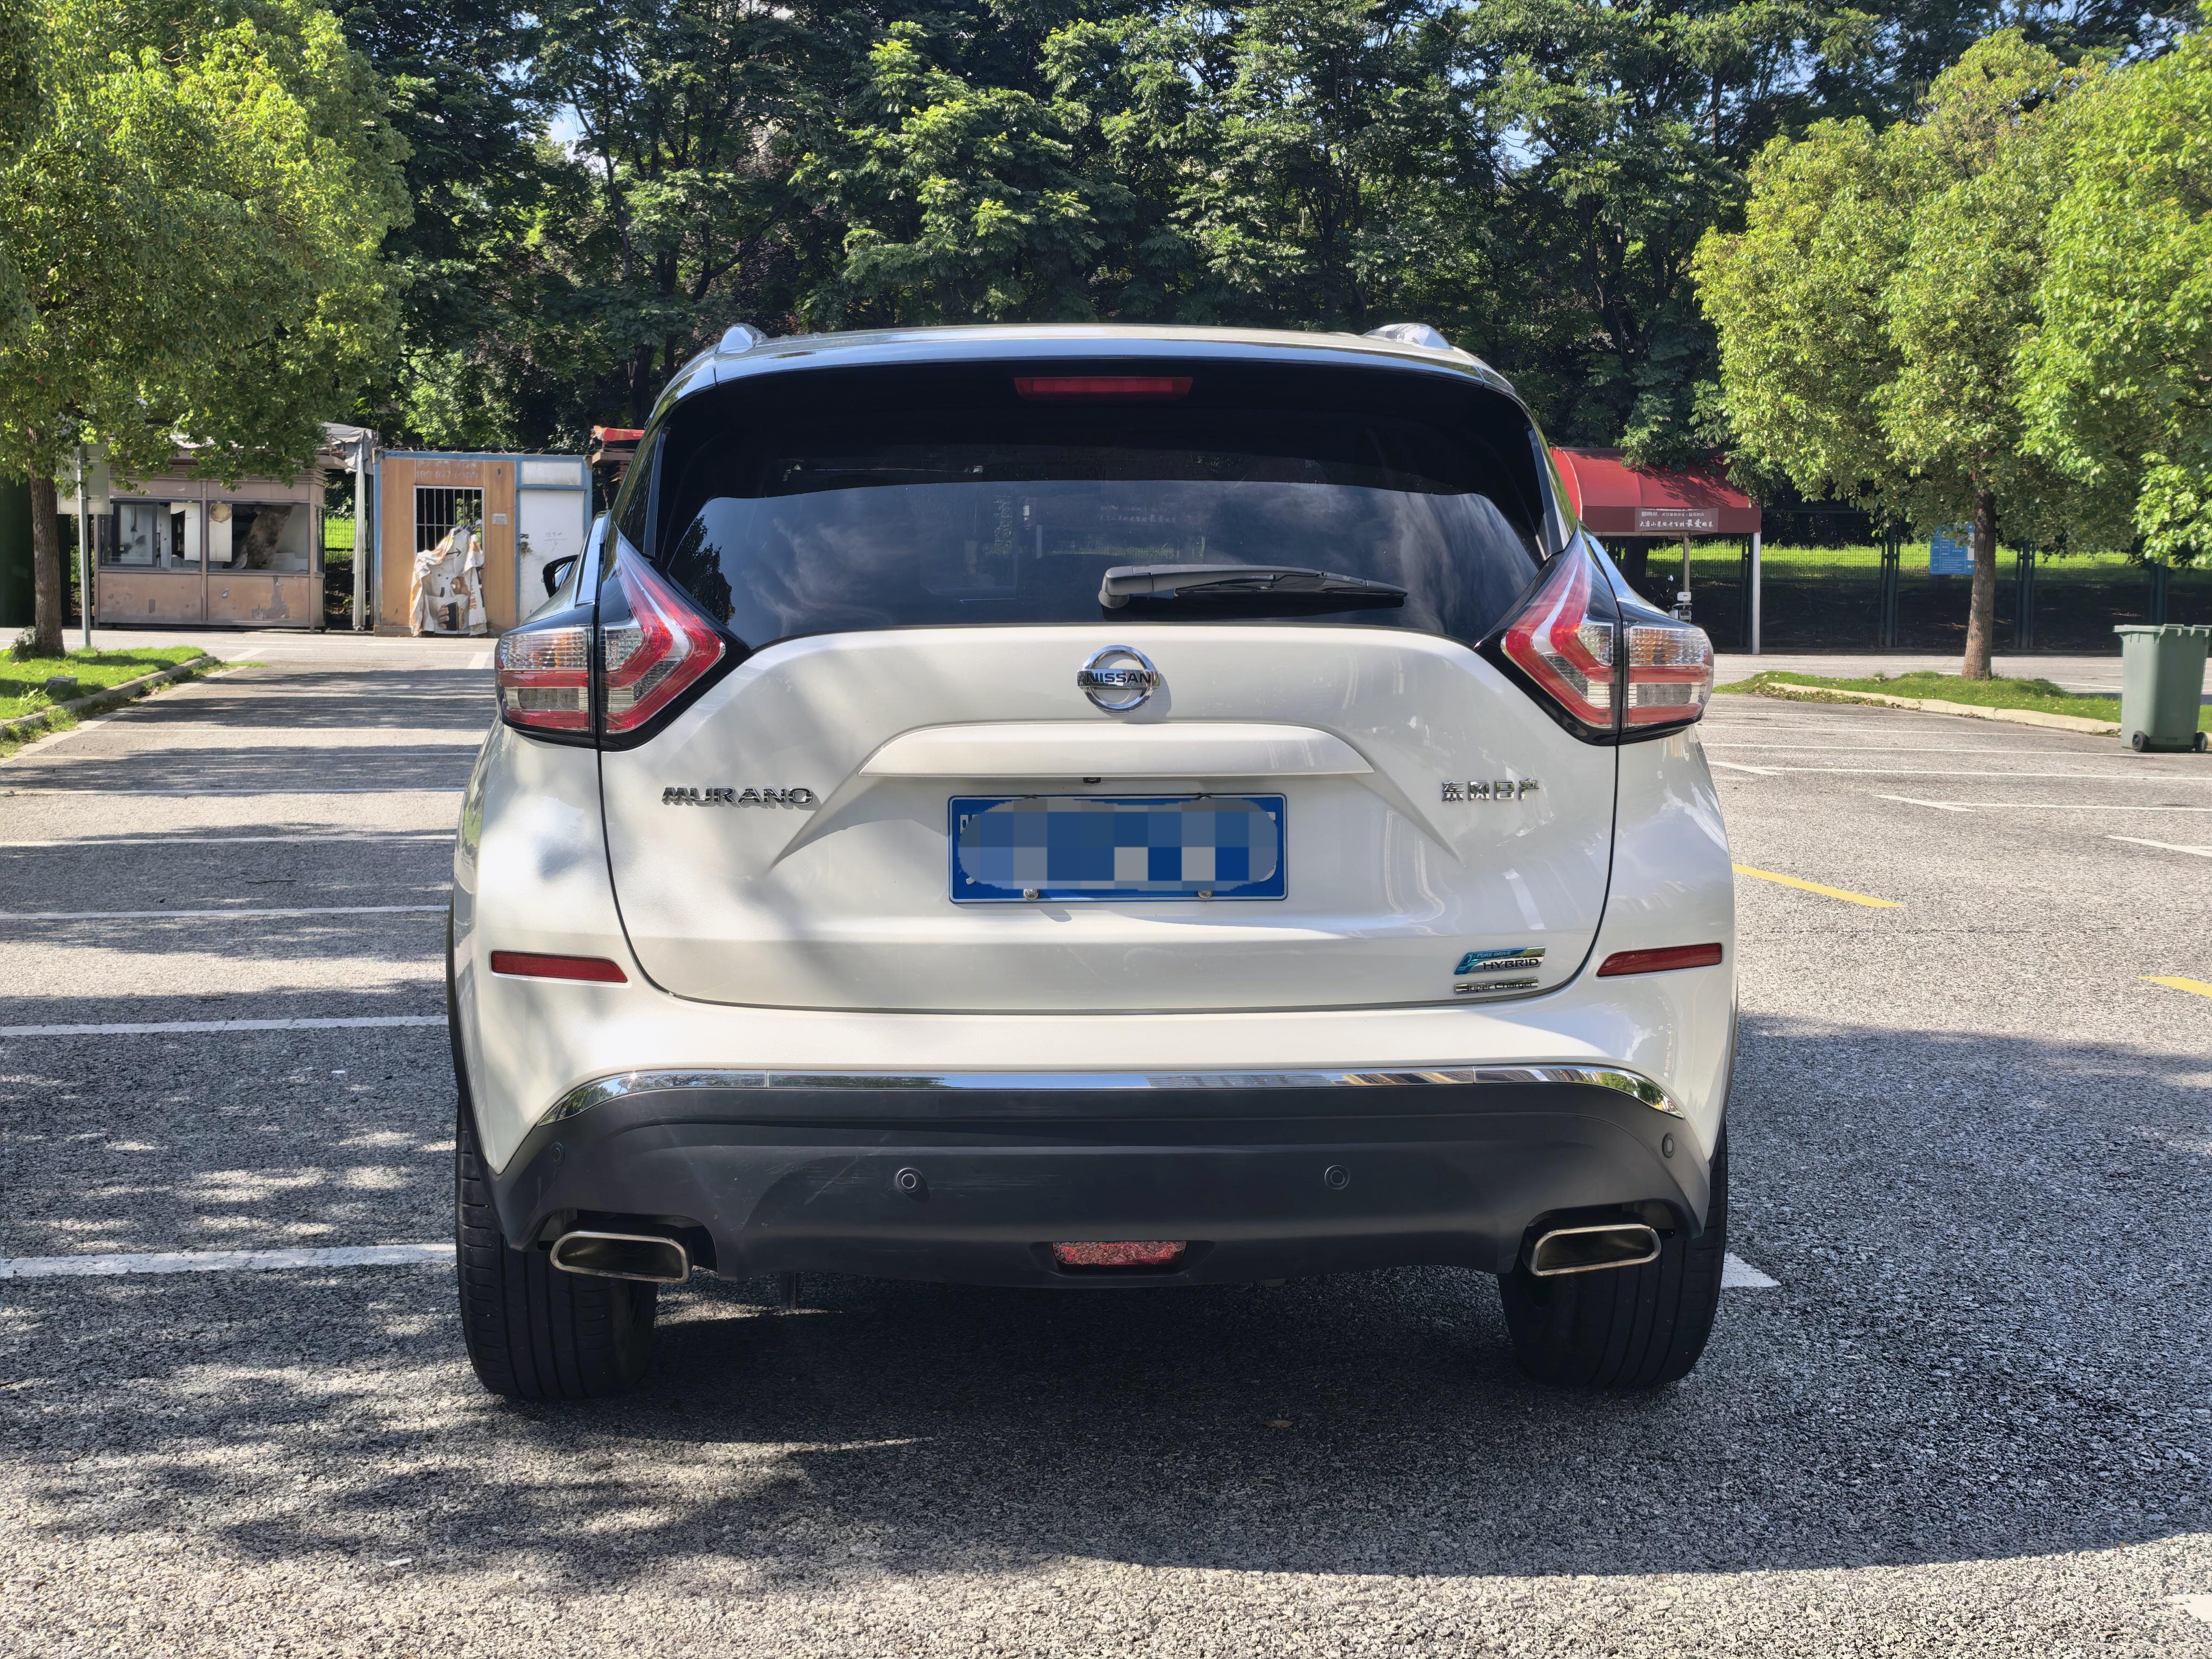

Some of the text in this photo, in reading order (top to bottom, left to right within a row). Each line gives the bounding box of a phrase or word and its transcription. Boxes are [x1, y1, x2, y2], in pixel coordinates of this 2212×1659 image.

[1086, 673, 1151, 684] NISSAN
[663, 787, 813, 805] MURANO
[1441, 779, 1539, 801] 东风日产
[1483, 959, 1539, 970] HYBRID
